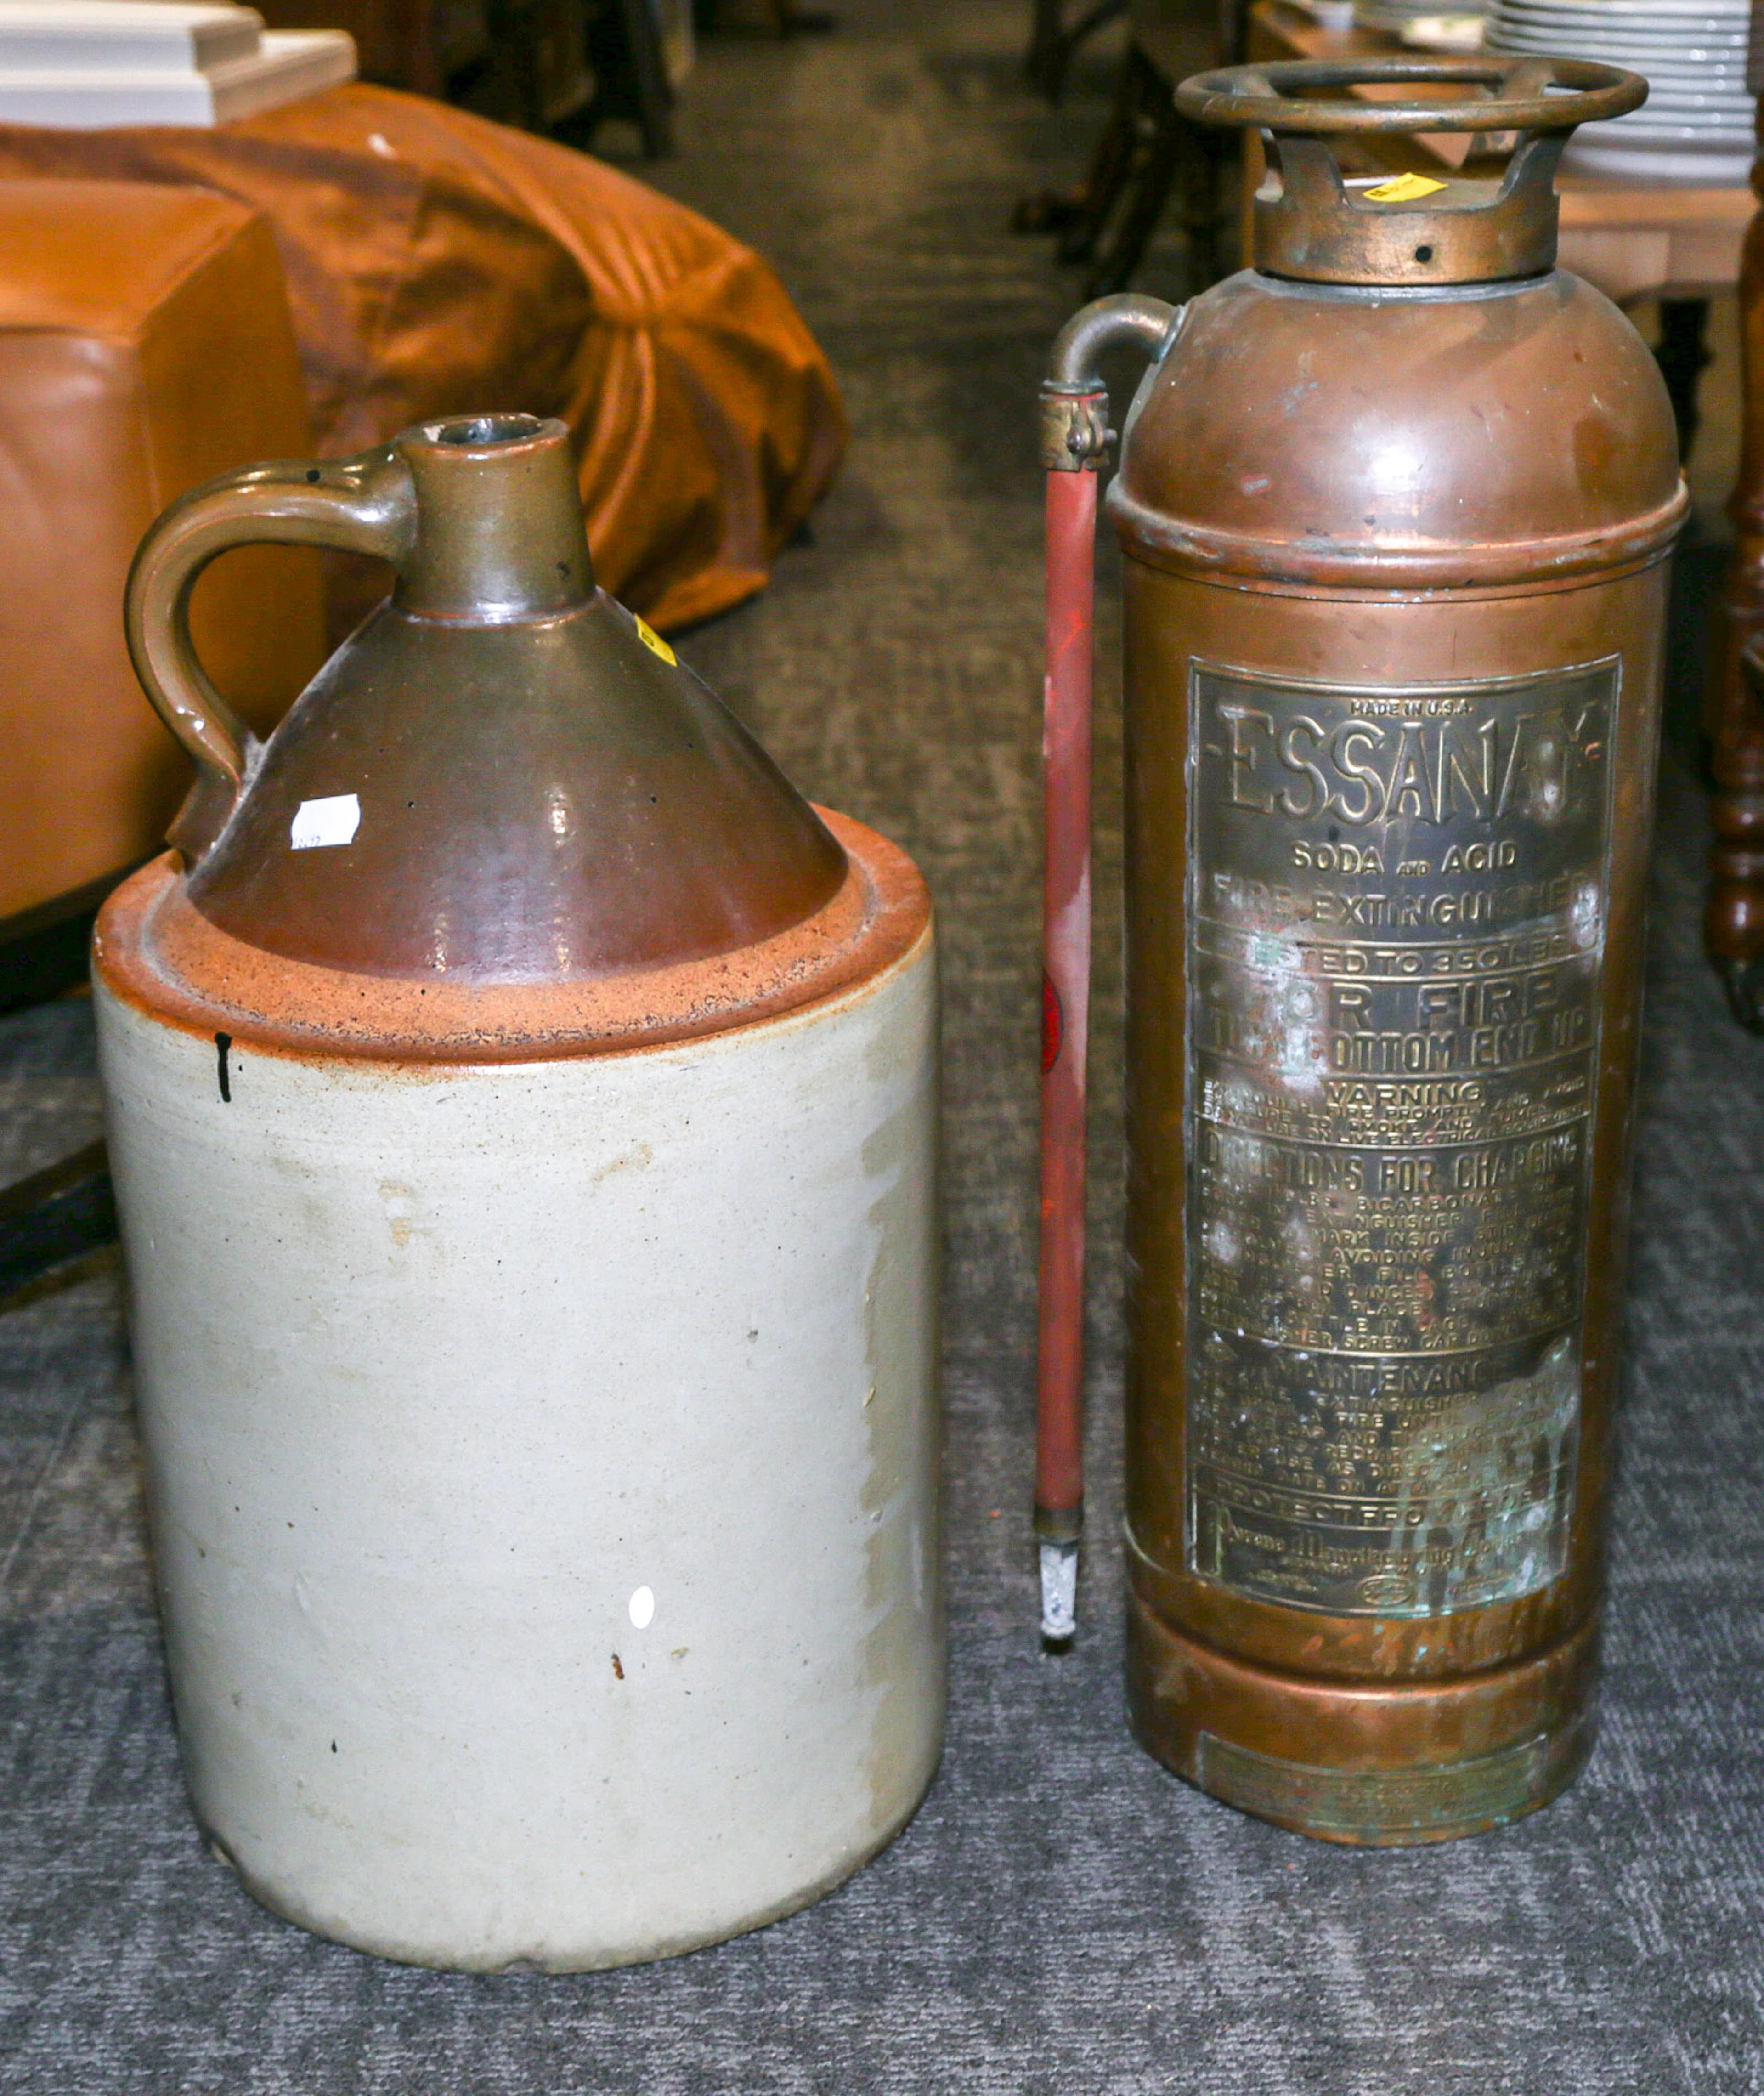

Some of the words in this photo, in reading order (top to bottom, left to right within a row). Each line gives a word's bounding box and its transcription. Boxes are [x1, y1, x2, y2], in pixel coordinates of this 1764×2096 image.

[1350, 699, 1399, 716] MADE
[1403, 699, 1423, 716] IN
[1292, 838, 1385, 875] SODA
[1396, 859, 1430, 875] AND
[1441, 838, 1517, 874] ACID
[1311, 870, 1601, 930] EXTINGUIHE
[1232, 933, 1369, 975] ESTED
[1375, 949, 1425, 976] TO
[1430, 945, 1501, 973] 350
[1416, 967, 1560, 1037] FIRE
[1321, 1079, 1483, 1105] WARNING
[1432, 1115, 1474, 1132] AND
[1200, 1125, 1366, 1194] DCTIONS
[1378, 1152, 1434, 1195] FOR
[1330, 1244, 1436, 1264] AVOIDING
[1349, 1298, 1424, 1318] PLACE
[1273, 1350, 1510, 1392] AINTENANC
[1216, 1473, 1353, 1524] PROTECT
